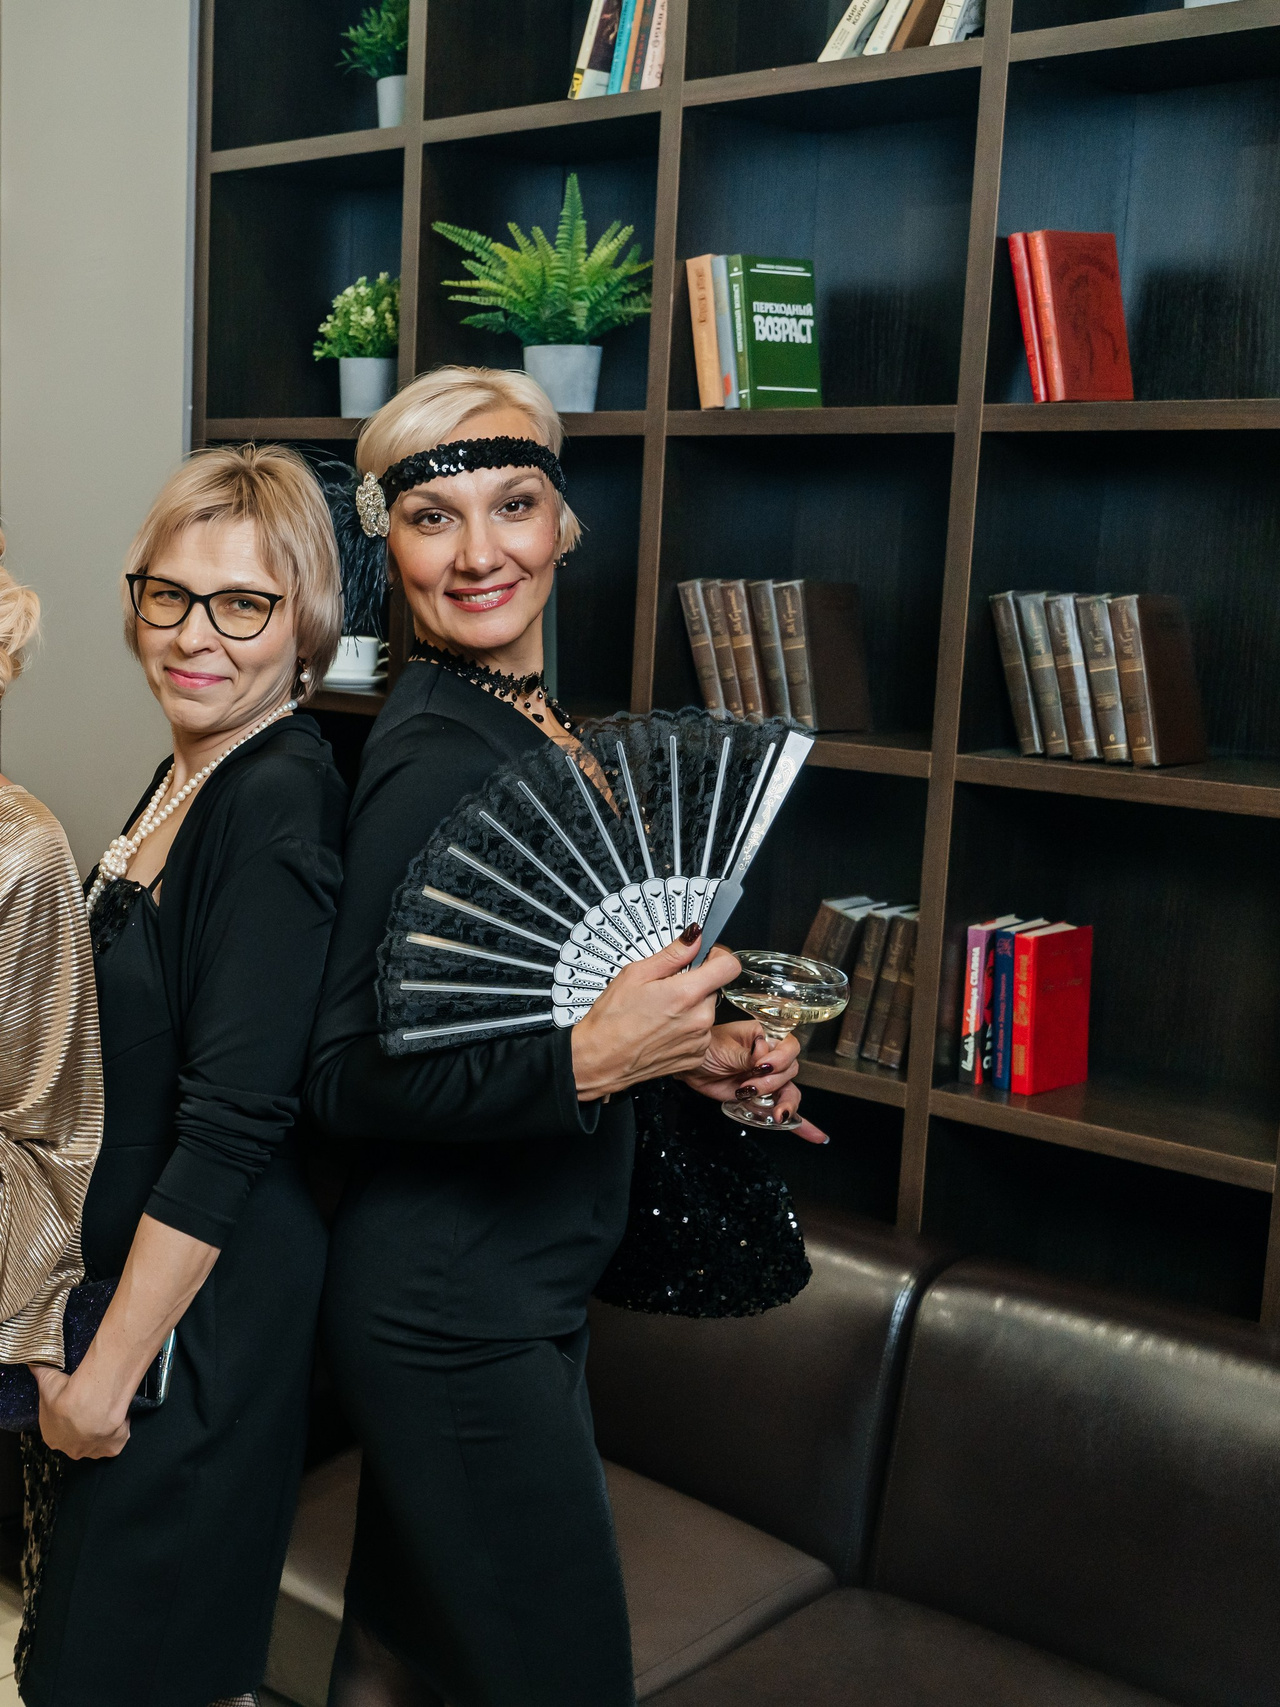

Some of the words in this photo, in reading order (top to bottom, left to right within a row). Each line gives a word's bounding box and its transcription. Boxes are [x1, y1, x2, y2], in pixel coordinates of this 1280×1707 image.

[846, 4, 858, 23] МИР
[851, 0, 870, 26] КОРАЛ
[752, 301, 814, 317] ПЕРЕХОДНЫЙ
[752, 315, 815, 344] ВОЗРАСТ
